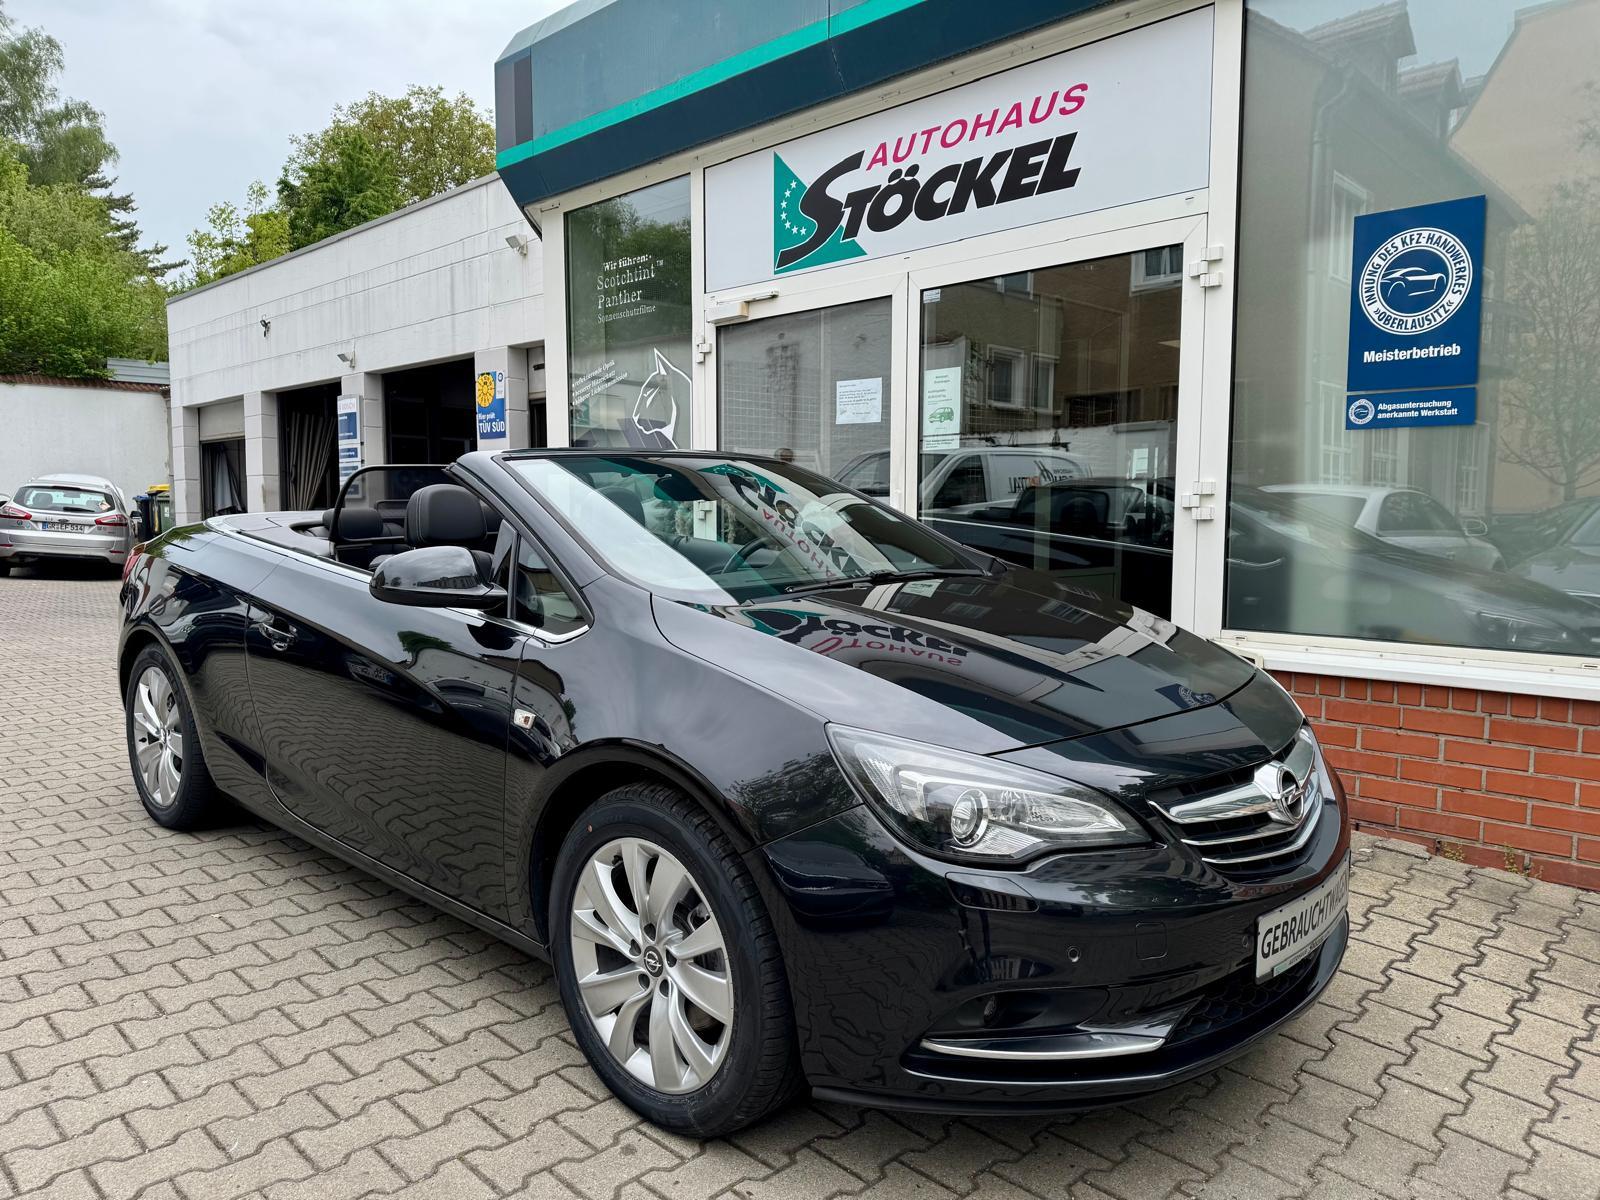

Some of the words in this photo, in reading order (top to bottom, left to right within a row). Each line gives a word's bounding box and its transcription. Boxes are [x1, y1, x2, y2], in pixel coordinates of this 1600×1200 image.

[866, 83, 1088, 171] AUTOHAUS
[775, 131, 1081, 270] STÖCKEL
[597, 263, 655, 290] Scotchtint
[1364, 262, 1382, 307] INNUNG
[1380, 242, 1399, 262] DES
[1400, 232, 1467, 296] KFZ-HANDWERKES
[598, 289, 642, 309] Panther
[1363, 343, 1461, 363] Meisterbetrieb
[1377, 399, 1452, 413] Abgasuntersuchung
[1377, 409, 1419, 418] anerkannte
[1420, 407, 1458, 417] Werkstatt
[478, 420, 491, 433] TÜV
[492, 419, 505, 432] SÜD
